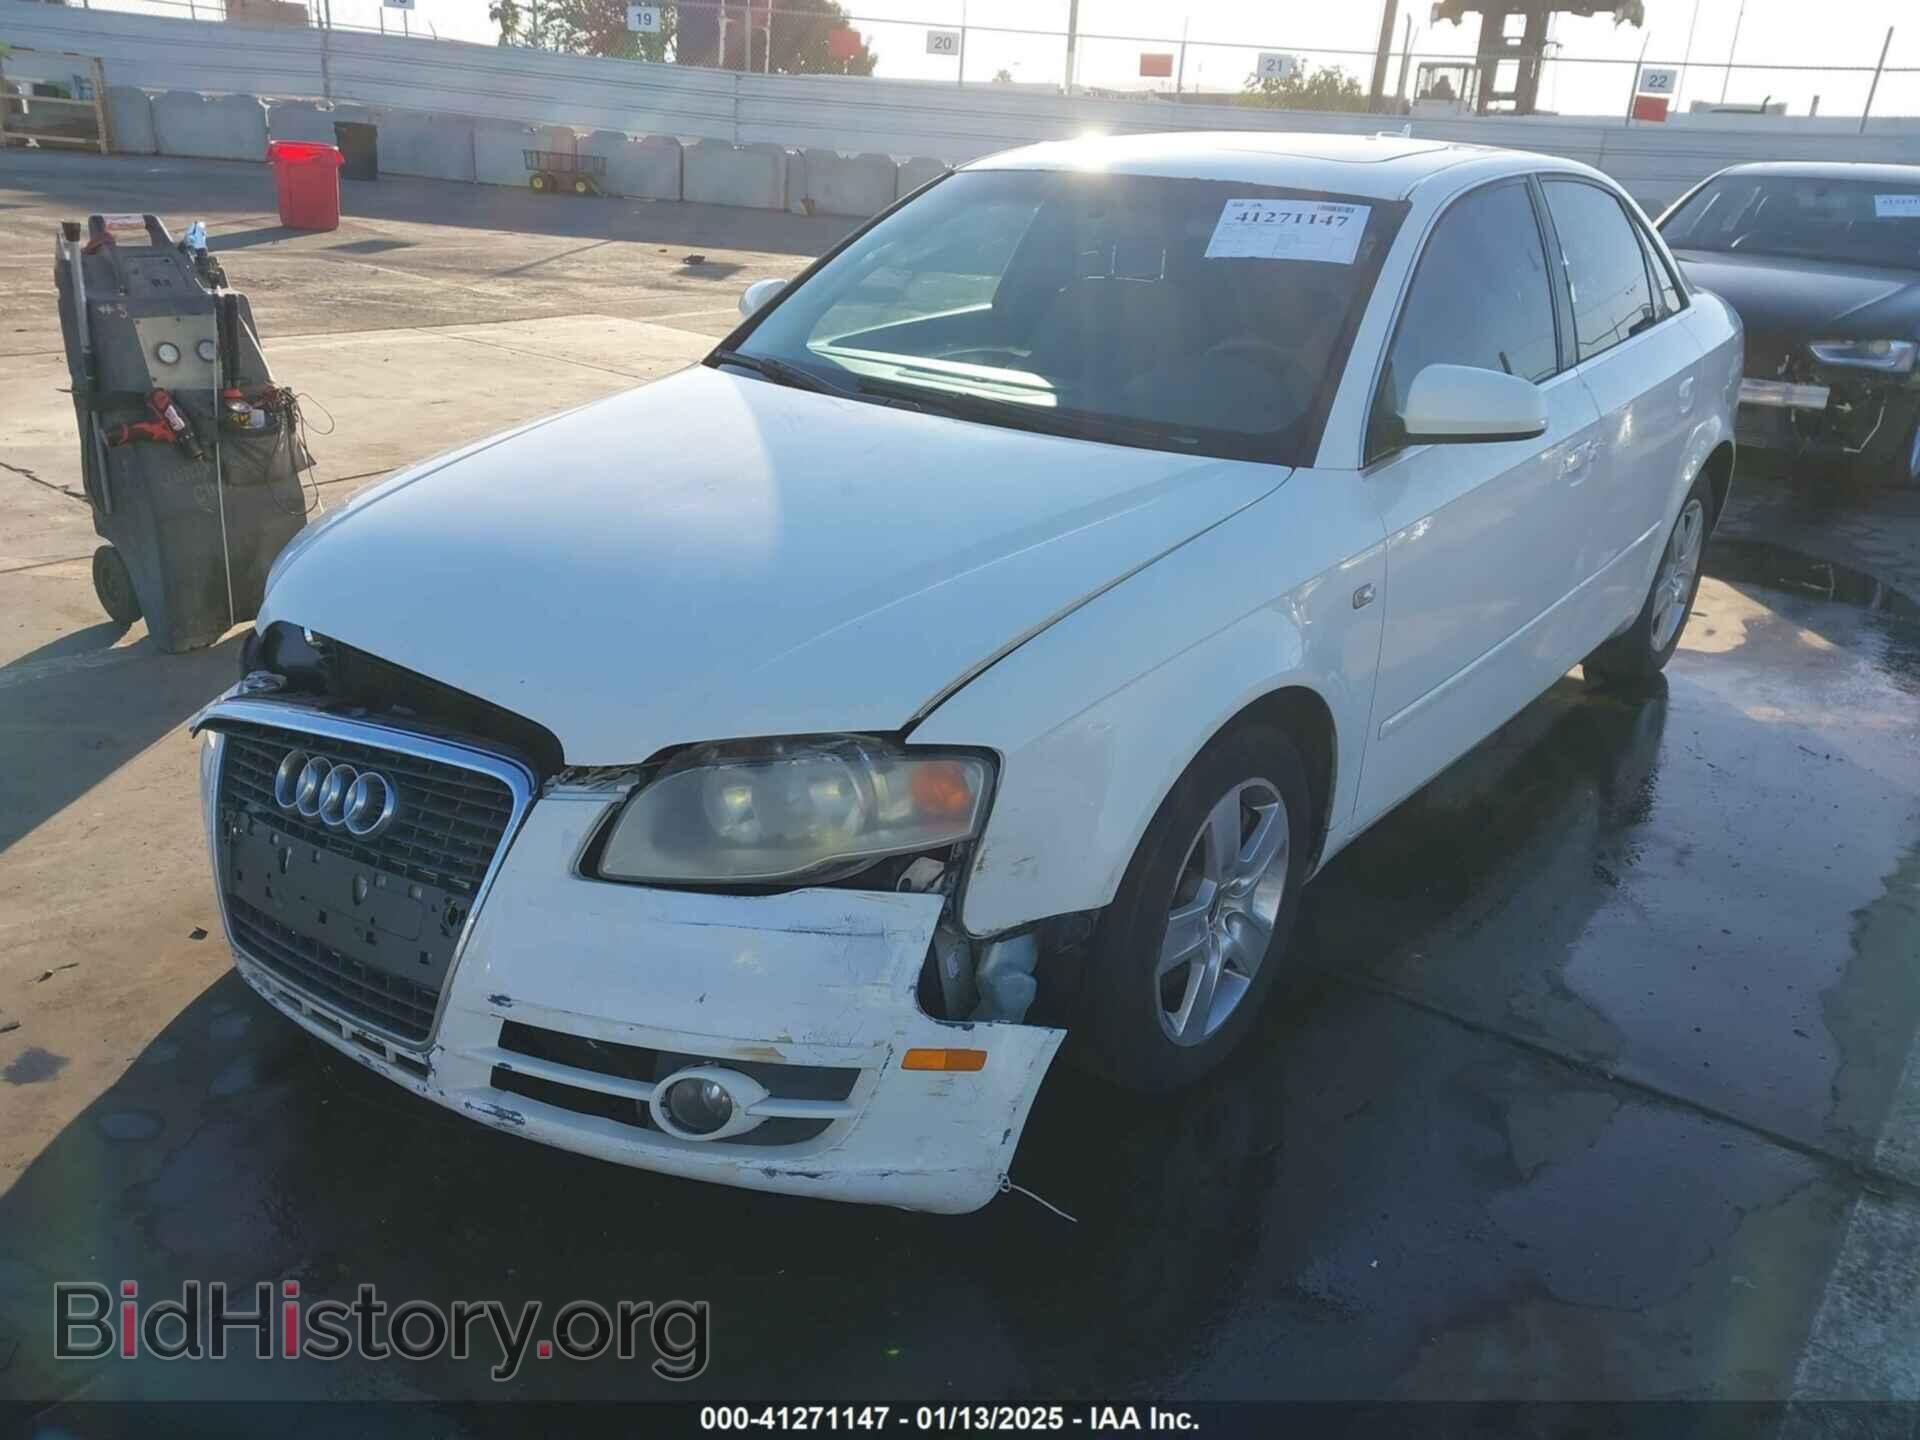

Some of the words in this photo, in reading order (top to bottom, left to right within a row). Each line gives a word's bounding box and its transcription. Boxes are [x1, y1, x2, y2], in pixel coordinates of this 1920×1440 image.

[636, 12, 652, 26] 19
[934, 36, 952, 50] 20
[1266, 58, 1282, 72] 21
[1648, 74, 1668, 88] 22
[1235, 211, 1350, 229] 41271147
